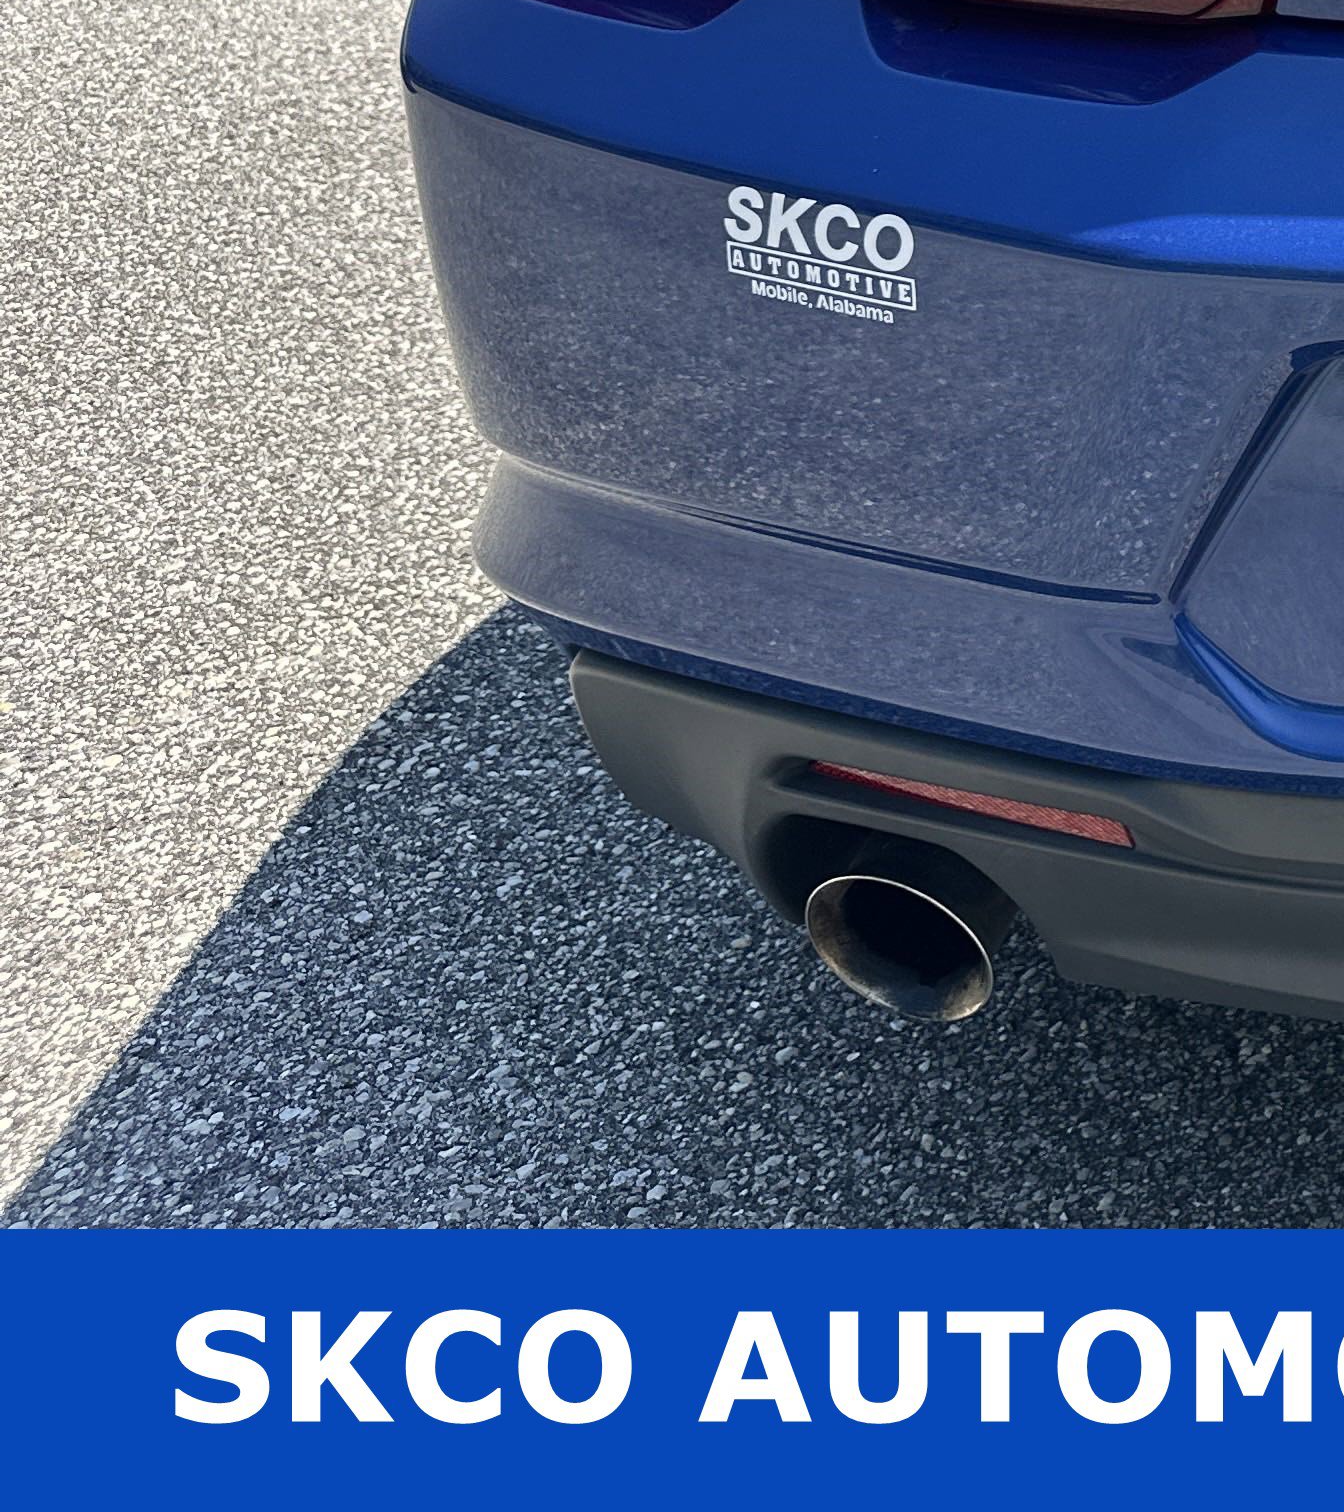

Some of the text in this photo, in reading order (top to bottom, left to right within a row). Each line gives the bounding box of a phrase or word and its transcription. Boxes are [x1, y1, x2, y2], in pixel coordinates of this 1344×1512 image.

[724, 186, 915, 272] SKCO
[731, 249, 913, 303] AUTOMOTIVE
[751, 279, 894, 324] Mobile, Alabama
